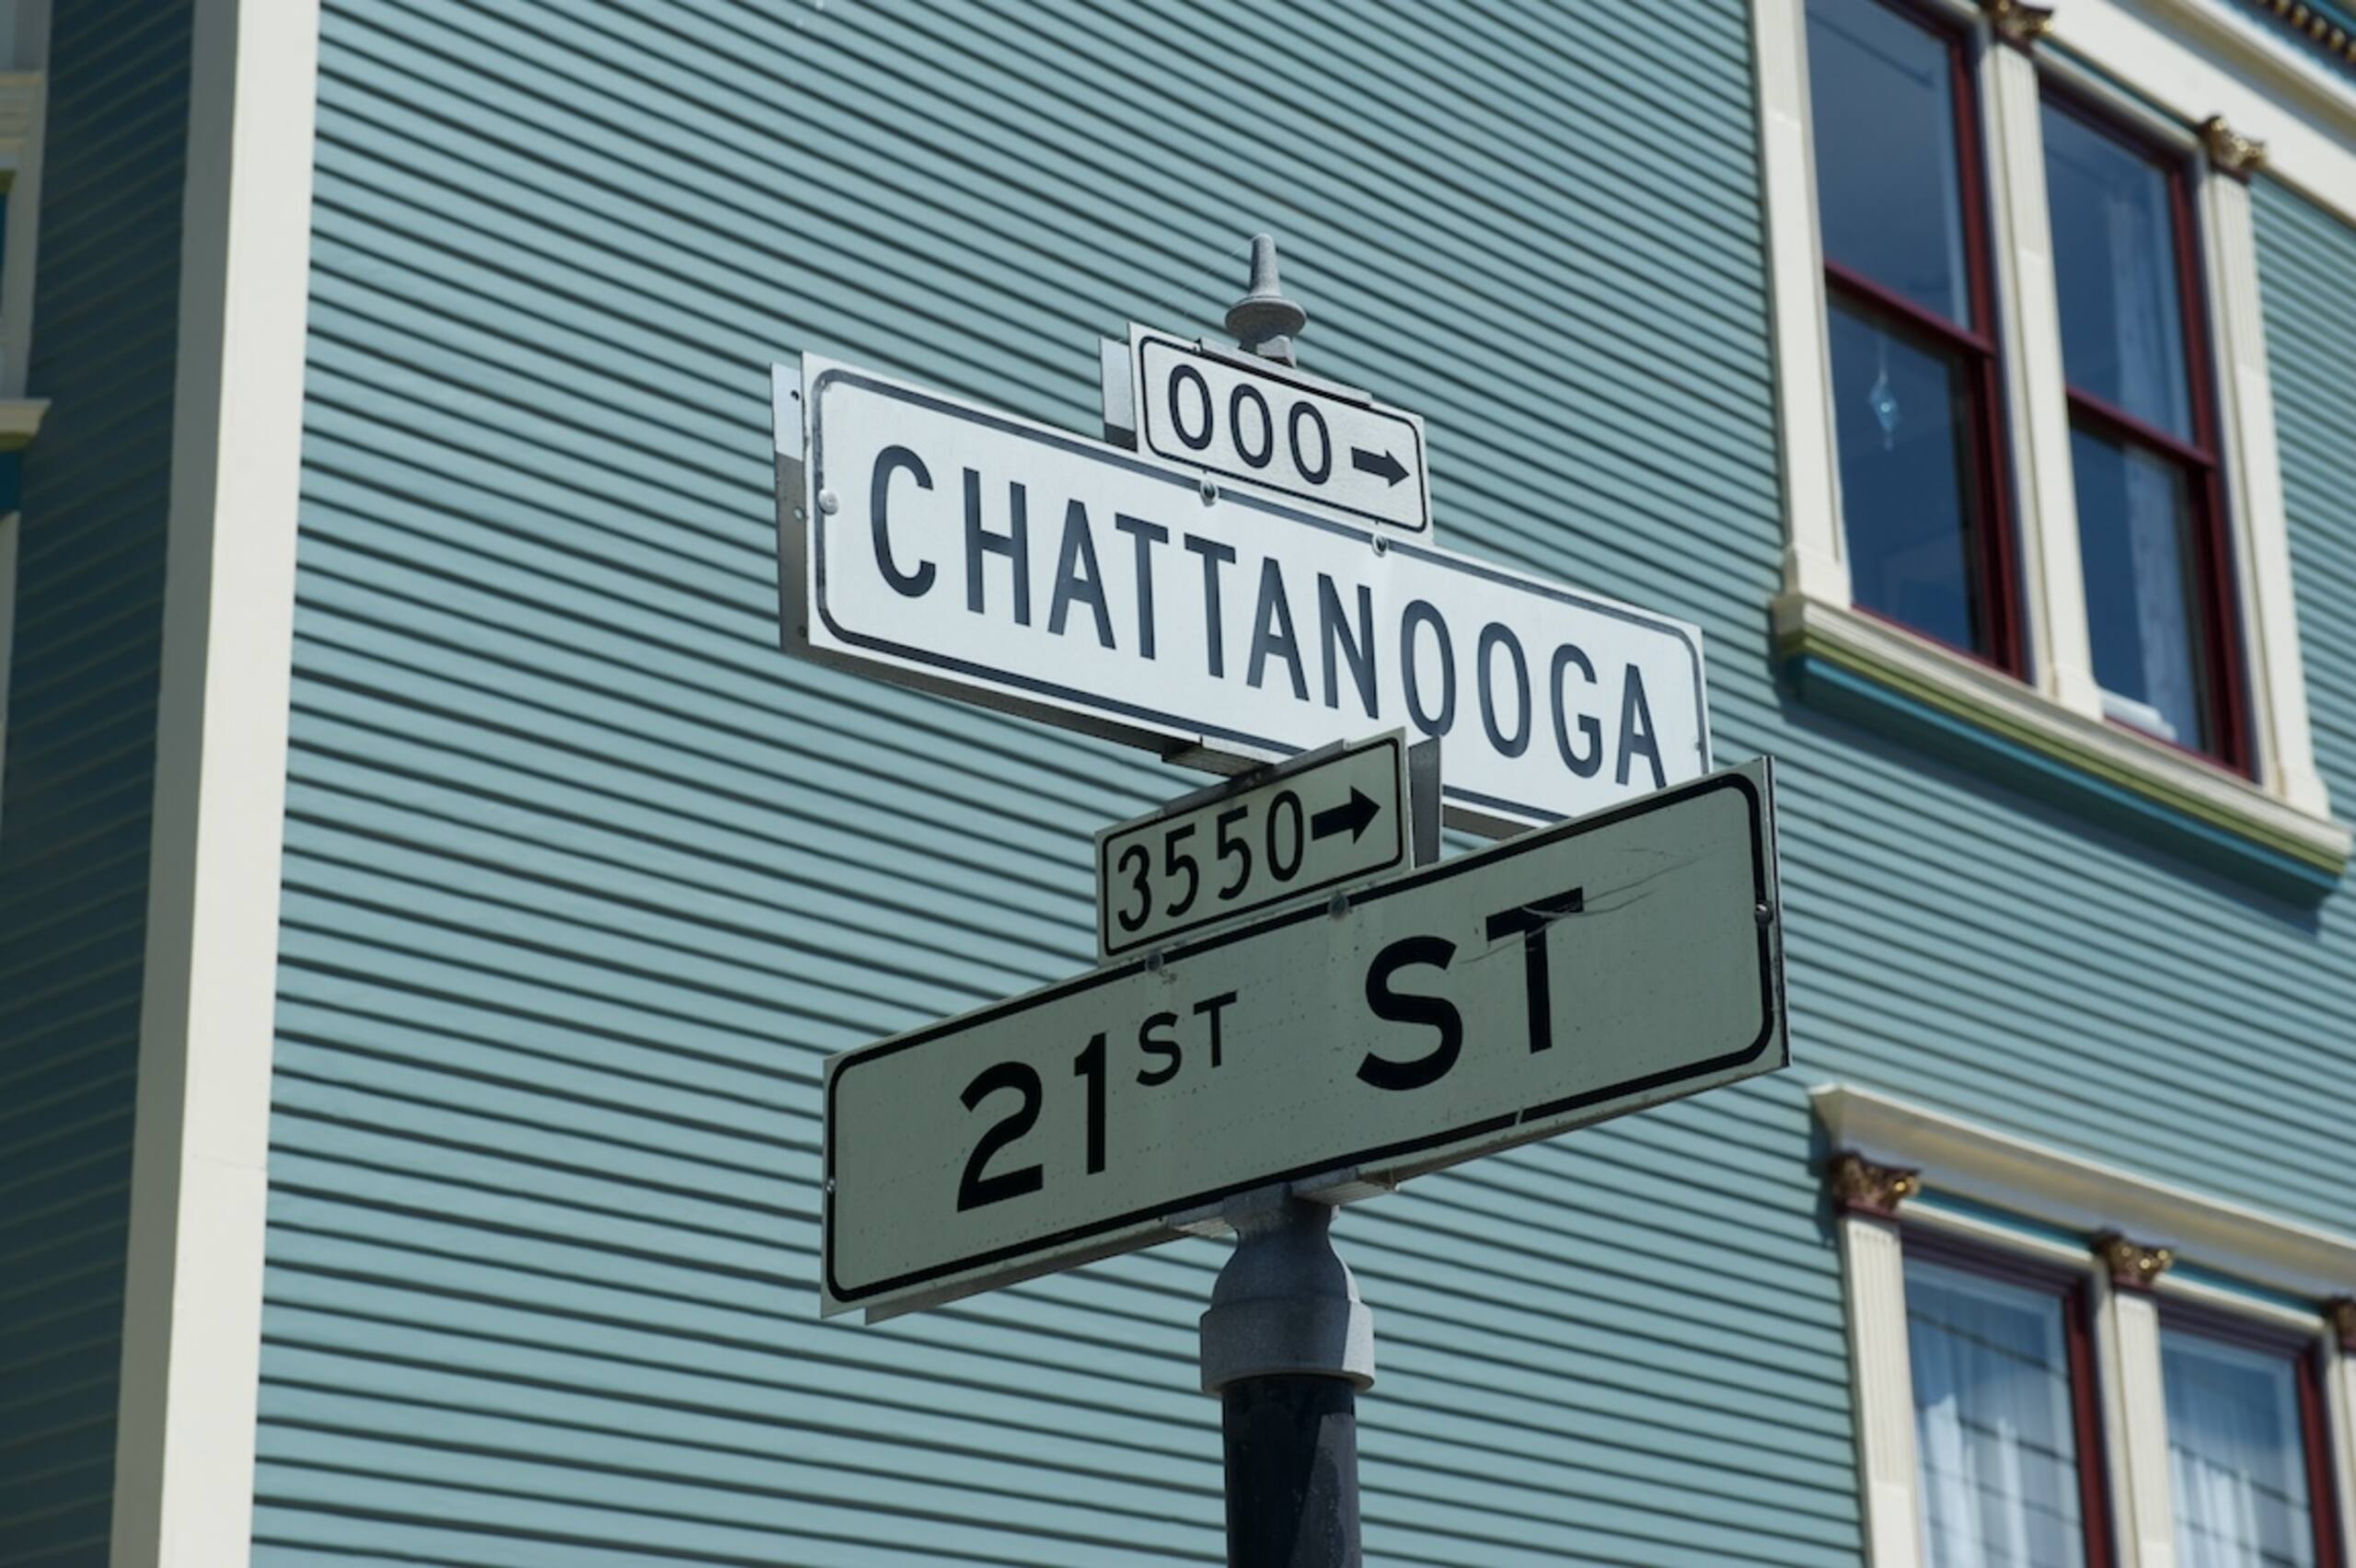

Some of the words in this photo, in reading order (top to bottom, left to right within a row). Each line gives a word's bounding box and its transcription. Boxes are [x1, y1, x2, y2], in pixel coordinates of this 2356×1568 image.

[1167, 363, 1334, 486] 000
[869, 444, 1668, 790] CHATTANOOGA
[1116, 789, 1305, 933] 3550
[956, 990, 1238, 1213] 21ST
[1356, 886, 1586, 1092] ST
